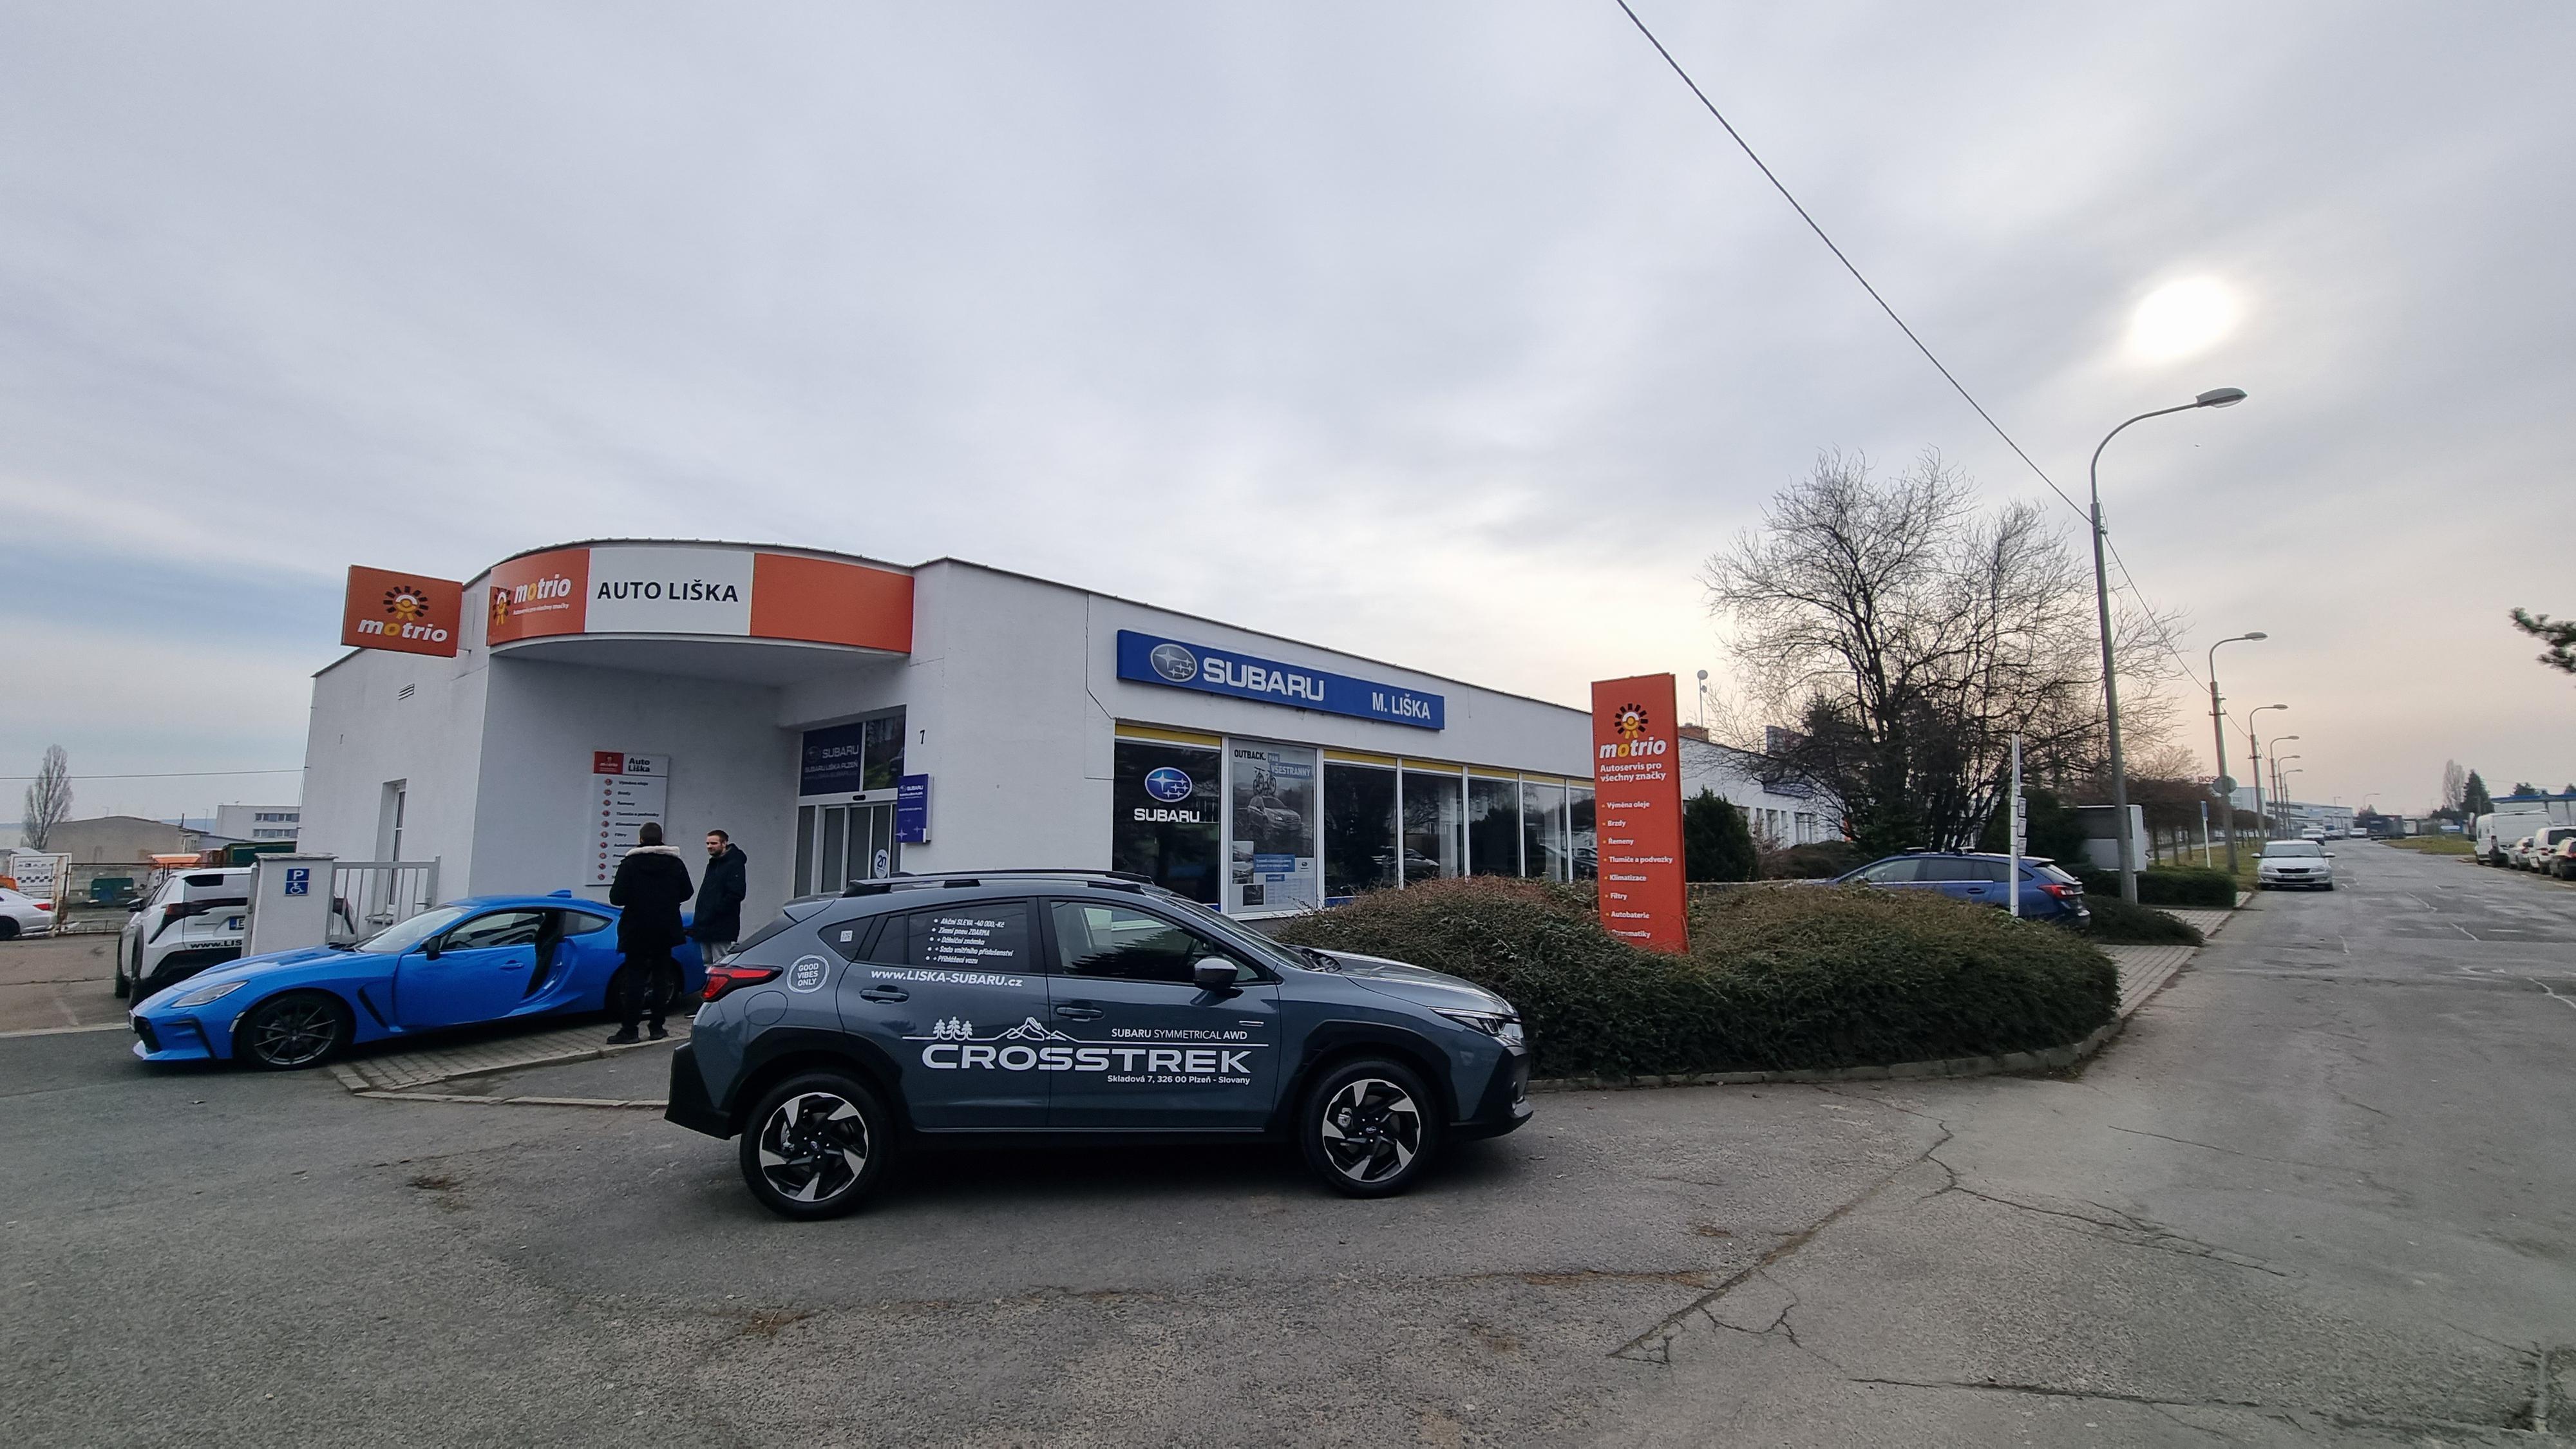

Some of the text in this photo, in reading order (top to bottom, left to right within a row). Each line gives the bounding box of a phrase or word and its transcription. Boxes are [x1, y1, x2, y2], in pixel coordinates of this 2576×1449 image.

[514, 574, 571, 603] motrio
[597, 579, 739, 602] AUTO LIŠKA
[357, 619, 448, 642] motrio
[1203, 657, 1324, 701] SUBARU
[1372, 692, 1431, 719] M. LIŠKA
[822, 744, 859, 759] SUBARU
[1599, 736, 1667, 759] motrio
[1234, 750, 1266, 761] OUTBACK.
[1271, 762, 1311, 777] VŠESTRANNÝ
[1600, 762, 1662, 773] Autoservis pro
[1600, 772, 1667, 783] všechny značky
[1633, 800, 1650, 809] oleje
[1134, 808, 1200, 823] SUBARU
[1608, 837, 1634, 846] Řemeny
[1640, 856, 1673, 864] podvozky
[293, 869, 304, 880] P
[1610, 892, 1628, 900] Filtry
[1611, 911, 1650, 919] Autobaterie
[799, 963, 819, 972] GOOD
[797, 970, 819, 979] VIBES
[871, 969, 1023, 987] www.LISKA-SUBARU.cz
[797, 977, 817, 986] ONLY
[1112, 1028, 1248, 1039] SUBARU SYMMETRICAL AWD
[922, 1044, 1252, 1074] CROSSTREK
[1107, 1074, 1146, 1083] Skladová
[1147, 1075, 1155, 1084] 7,
[1218, 1076, 1251, 1085] Slovany
